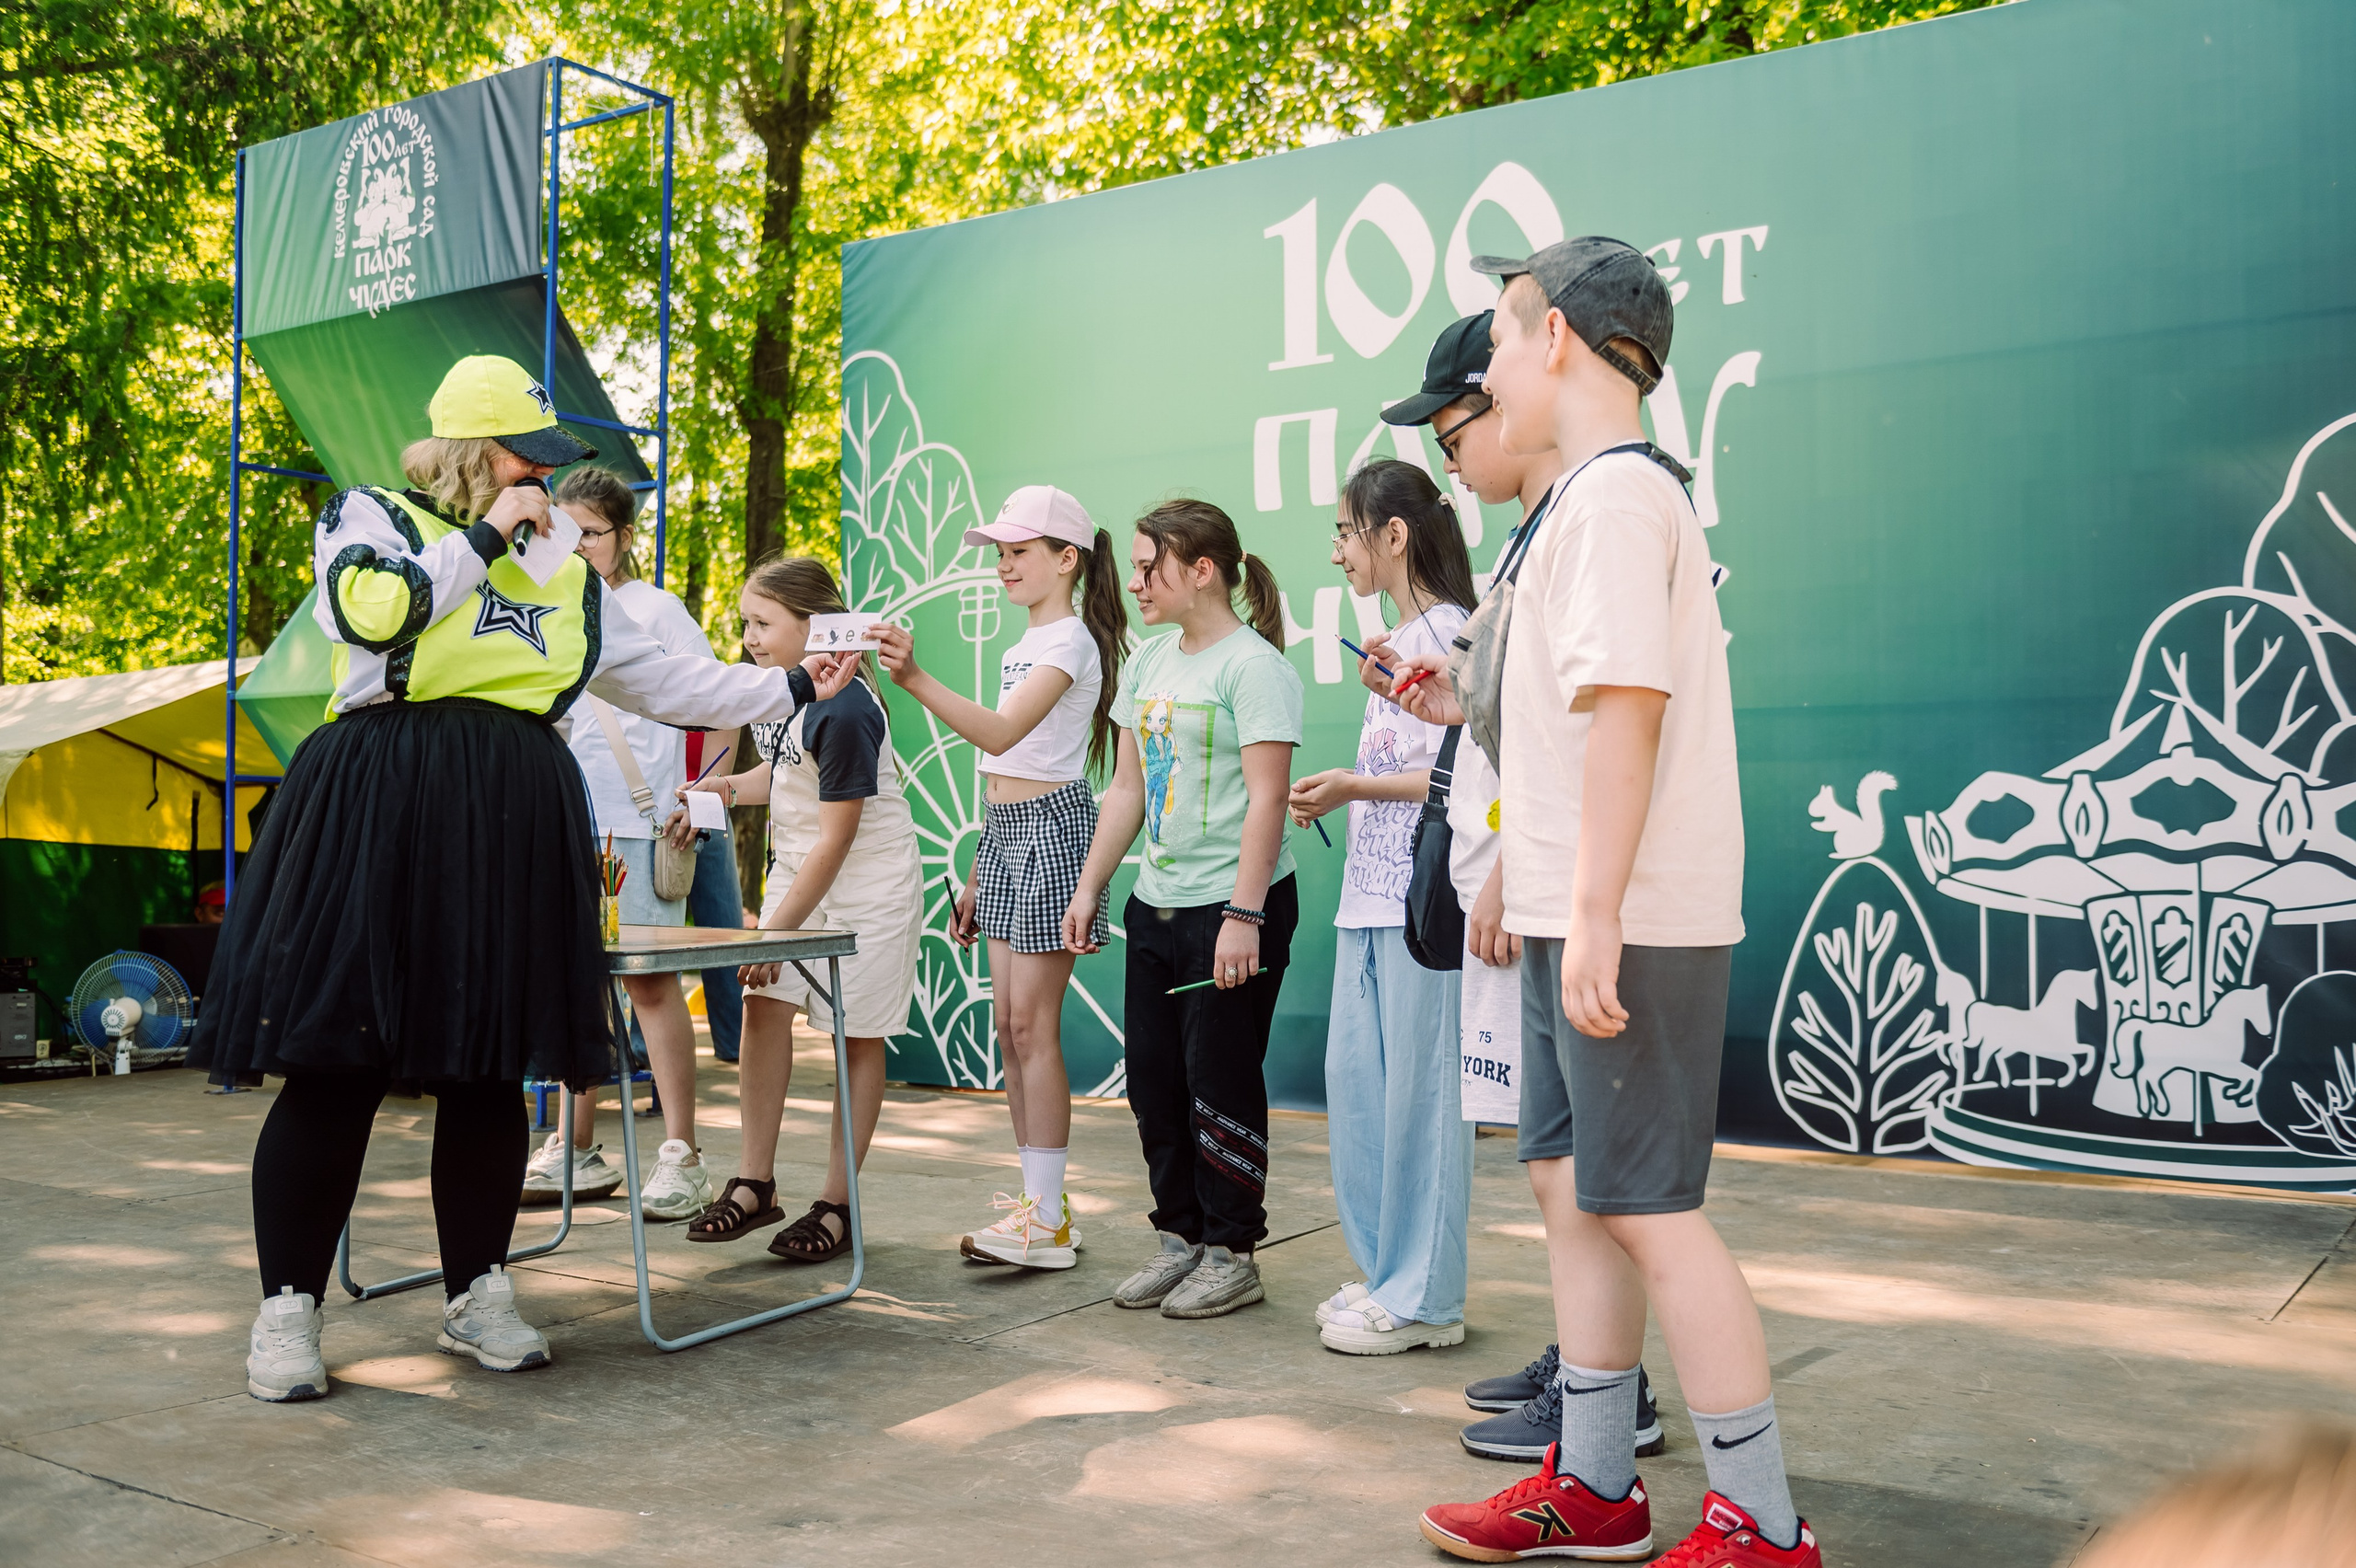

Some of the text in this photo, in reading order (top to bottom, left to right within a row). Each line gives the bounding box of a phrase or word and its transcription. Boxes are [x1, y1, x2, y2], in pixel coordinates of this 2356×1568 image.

[362, 130, 396, 167] 100
[1465, 372, 1487, 384] JORDA
[1478, 1031, 1492, 1043] 75
[1463, 1055, 1511, 1088] YORK
